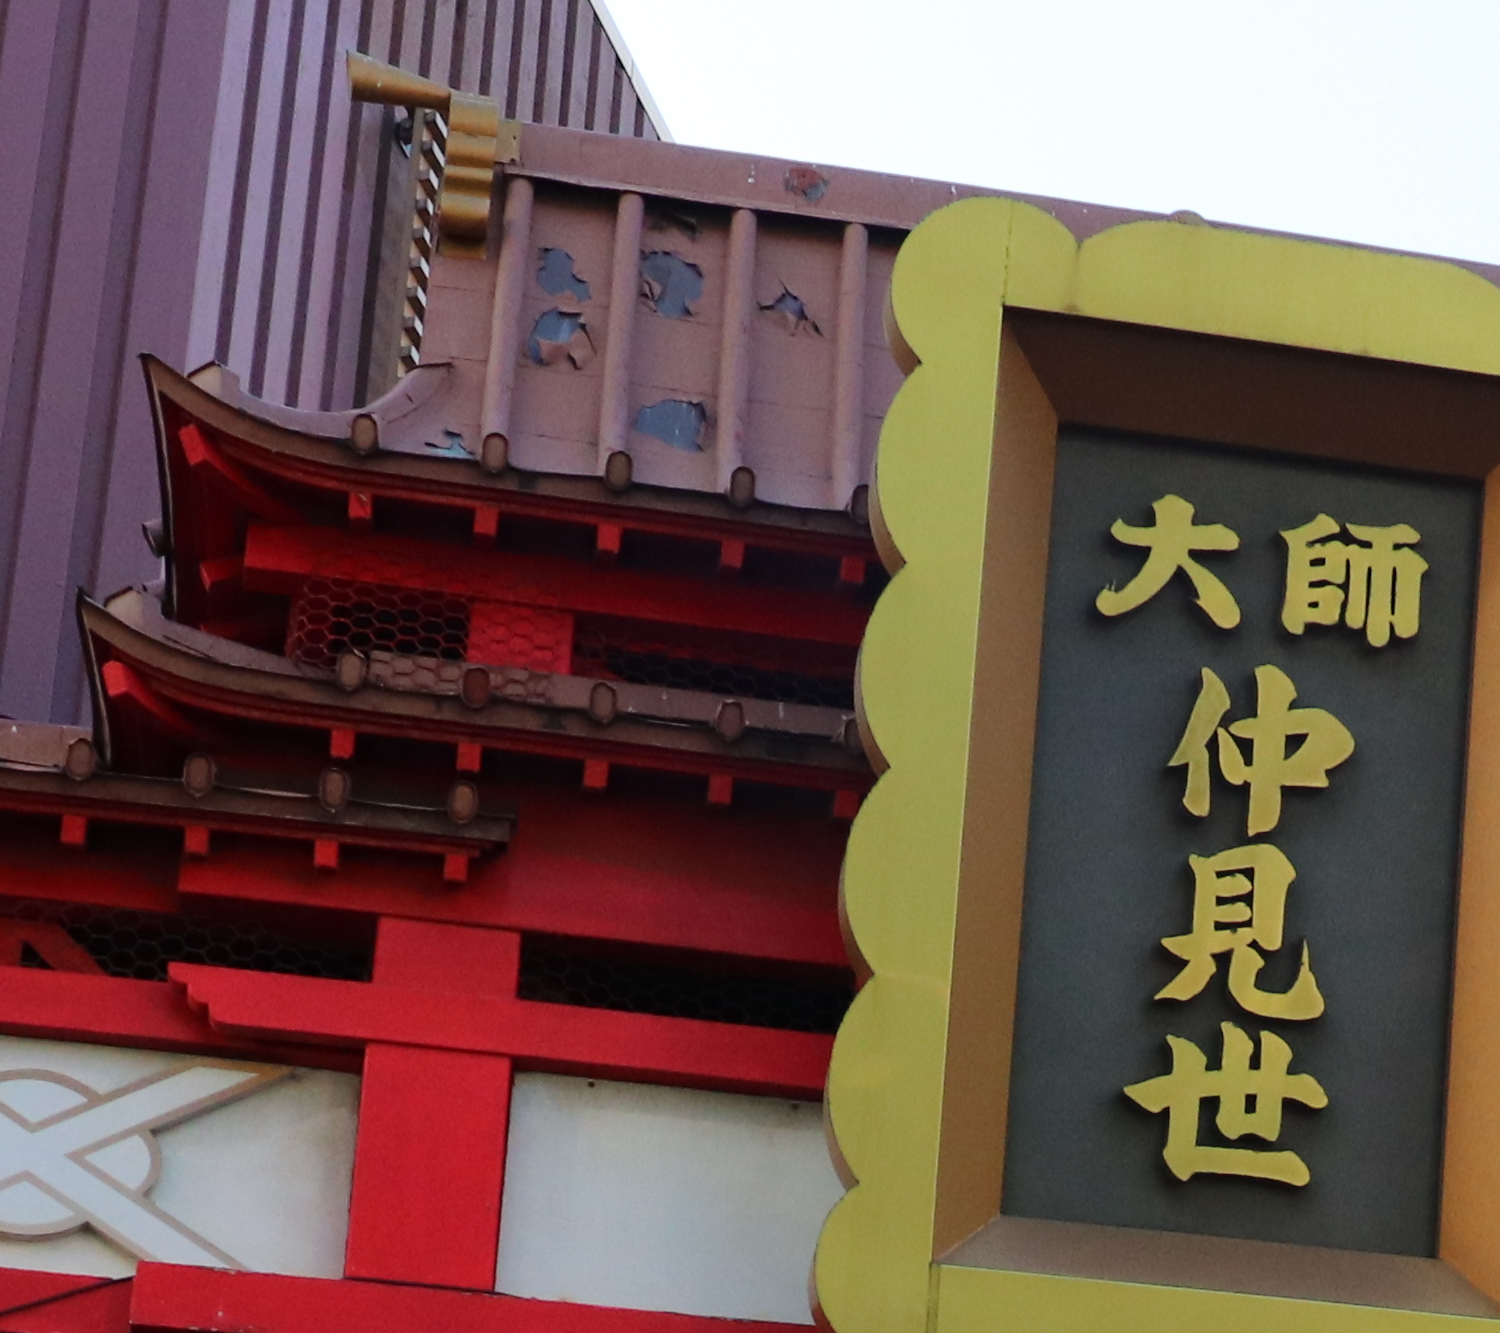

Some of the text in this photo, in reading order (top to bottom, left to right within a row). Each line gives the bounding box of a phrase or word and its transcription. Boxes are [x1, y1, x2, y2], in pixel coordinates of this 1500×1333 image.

[1096, 493, 1430, 648] 大師
[1123, 663, 1357, 1188] 仲見世
